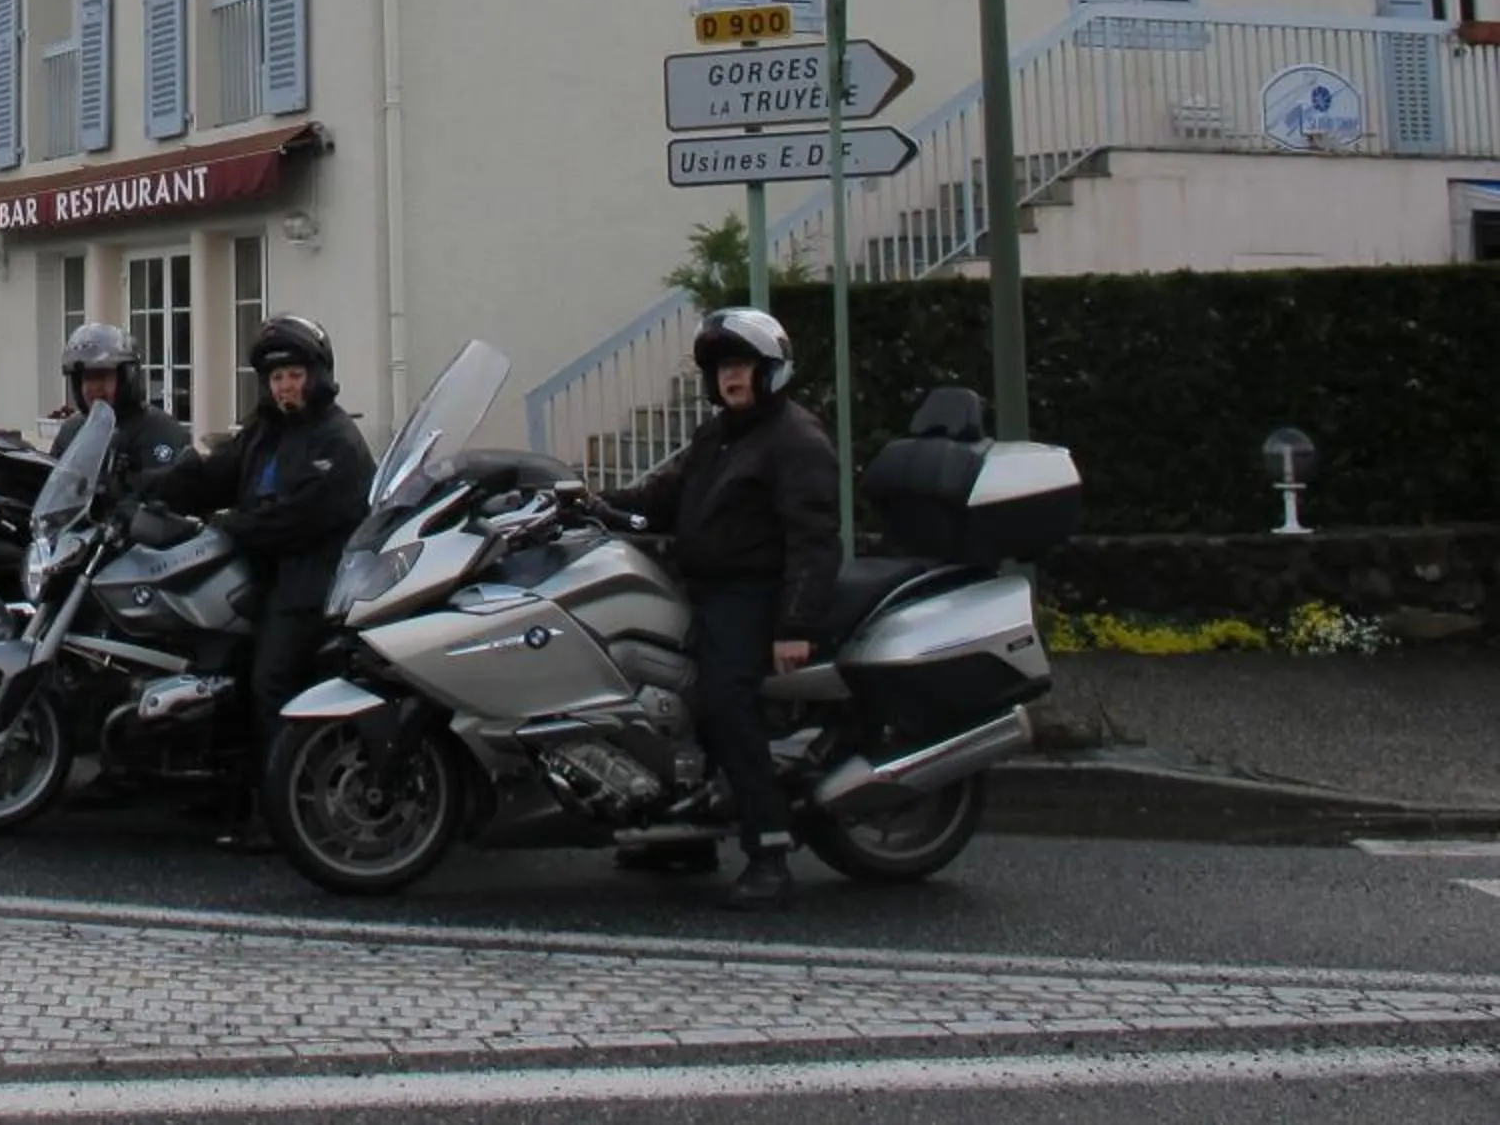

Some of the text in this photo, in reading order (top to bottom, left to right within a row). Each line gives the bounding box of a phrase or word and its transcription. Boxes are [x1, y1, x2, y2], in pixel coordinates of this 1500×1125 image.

[703, 11, 785, 38] D 900
[708, 56, 819, 87] GORGES
[710, 83, 859, 116] LA TRUYÈE
[680, 150, 768, 174] Usines
[55, 167, 210, 221] RESTAURANT
